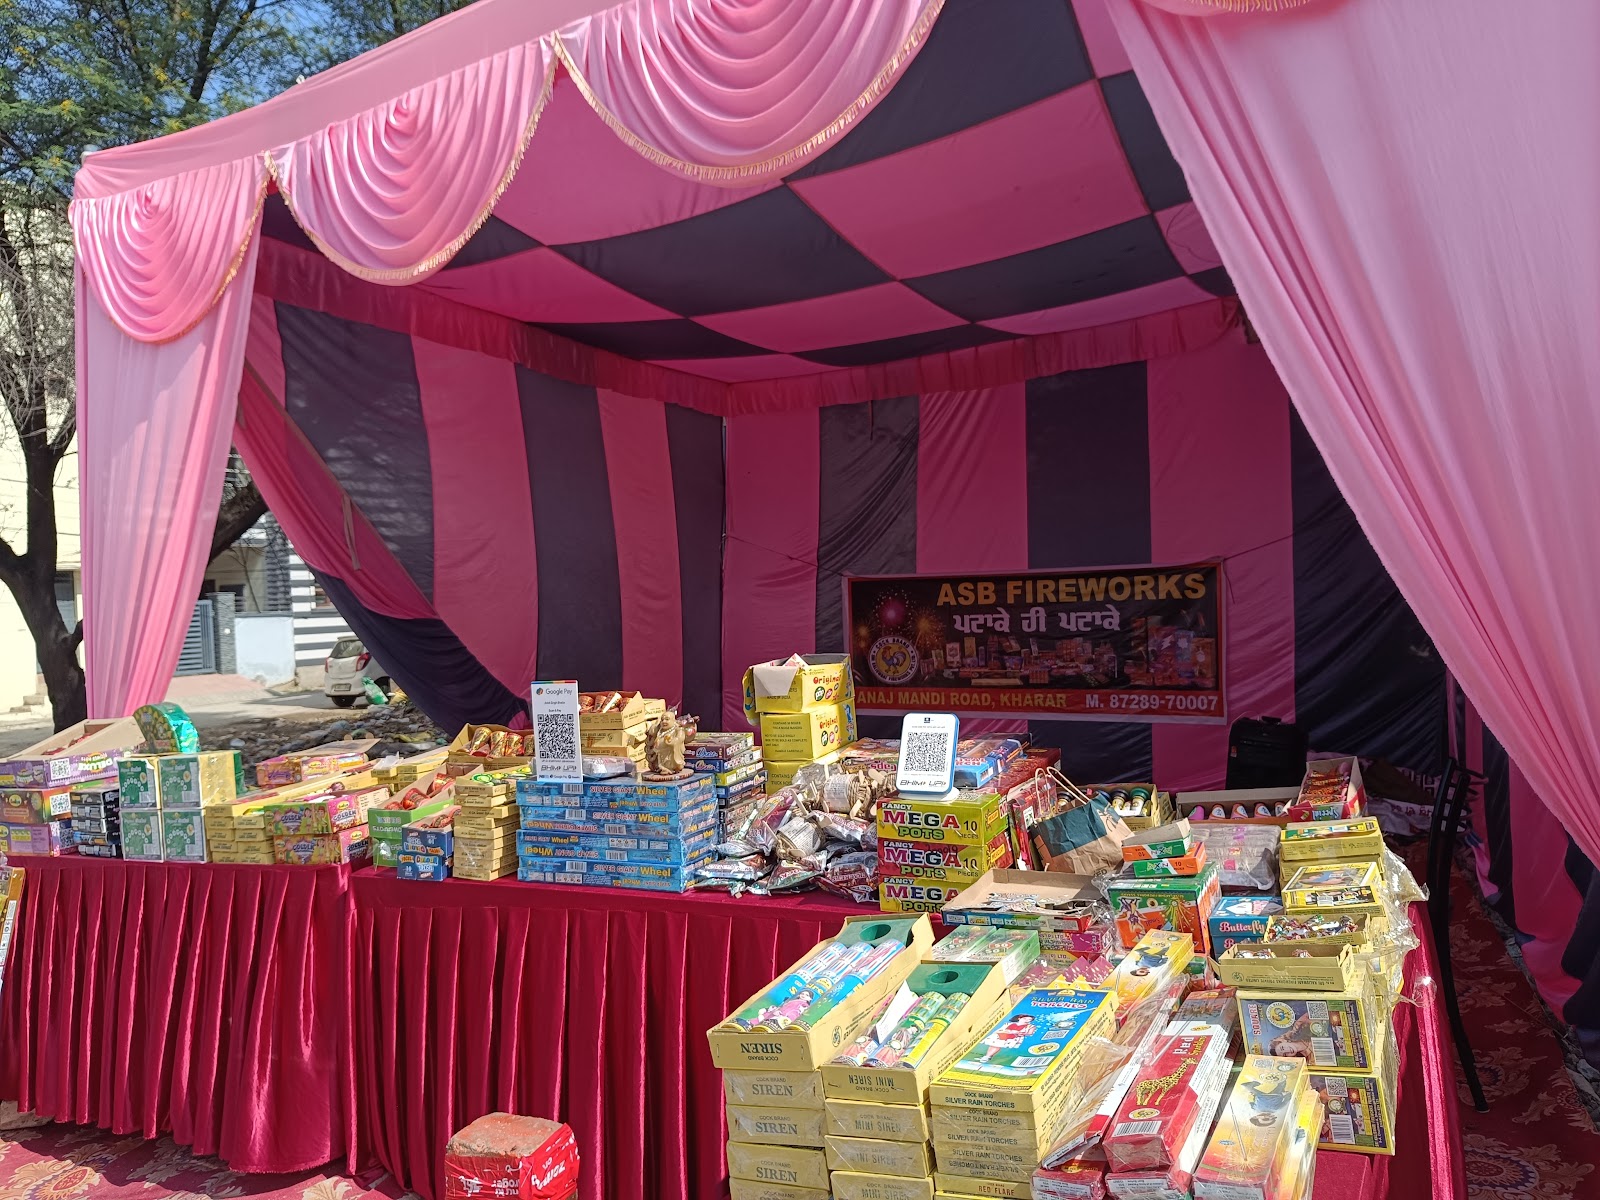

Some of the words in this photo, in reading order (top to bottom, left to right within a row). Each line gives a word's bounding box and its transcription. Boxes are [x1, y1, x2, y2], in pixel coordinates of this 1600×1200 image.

[937, 582, 998, 606] ASB
[1007, 573, 1207, 604] FIREWORKS
[954, 607, 1011, 634] ਪਟਾਕੇ
[1020, 607, 1048, 633] ਹੀ
[1060, 604, 1121, 632] ਪਟਾਕੇ
[813, 675, 841, 685] Original
[546, 688, 563, 696] Google
[564, 688, 573, 696] Pay
[899, 691, 946, 706] MANDI
[951, 692, 996, 709] ROAD,
[1001, 693, 1067, 708] KHARAR
[1086, 694, 1105, 709] M.
[1110, 694, 1218, 711] 87289-70007
[820, 715, 838, 729] Original
[900, 779, 925, 787] BHIM
[928, 779, 947, 788] UPI
[590, 786, 612, 794] SILVER
[635, 785, 667, 796] Wheel
[592, 812, 614, 820] SILVER
[615, 812, 637, 820] GIANT
[638, 812, 669, 823] Wheel
[1312, 806, 1340, 820] Special
[527, 821, 555, 829] Wheel
[883, 810, 960, 831] MEGA
[963, 820, 979, 831] 10
[551, 836, 569, 844] Wheel
[898, 827, 945, 842] POTS
[883, 841, 914, 849] FANCY
[525, 846, 554, 856] Wheel
[577, 849, 598, 857] SILVER
[884, 848, 962, 869] MEGA
[963, 858, 979, 870] 10
[594, 864, 616, 872] SILVER
[617, 865, 638, 873] GIANT
[640, 866, 671, 877] Wheel
[900, 865, 947, 879] POTS
[957, 870, 980, 878] PIECES
[883, 877, 915, 885] FANCY
[885, 884, 960, 902] MEGA
[1220, 921, 1266, 935] Butterfly
[1031, 1001, 1088, 1009] TORCHES
[1247, 1003, 1261, 1036] SQUARE
[741, 1043, 783, 1054] SIREN
[849, 1075, 872, 1086] SIREN
[875, 1076, 894, 1087] MINI
[752, 1084, 793, 1097] SIREN
[985, 1100, 1015, 1109] TORCHES
[950, 1114, 971, 1122] SILVER
[990, 1118, 1021, 1126] TORCHES
[755, 1122, 798, 1135] SIREN
[855, 1120, 874, 1130] MINI
[878, 1122, 901, 1133] SIREN
[987, 1137, 1018, 1145] TORCHES
[953, 1149, 975, 1157] SILVER
[992, 1153, 1023, 1162] TORCHES
[756, 1167, 797, 1183] SIREN
[861, 1189, 883, 1199] MINI
[978, 1185, 994, 1194] RED
[995, 1187, 1015, 1196] FLARE
